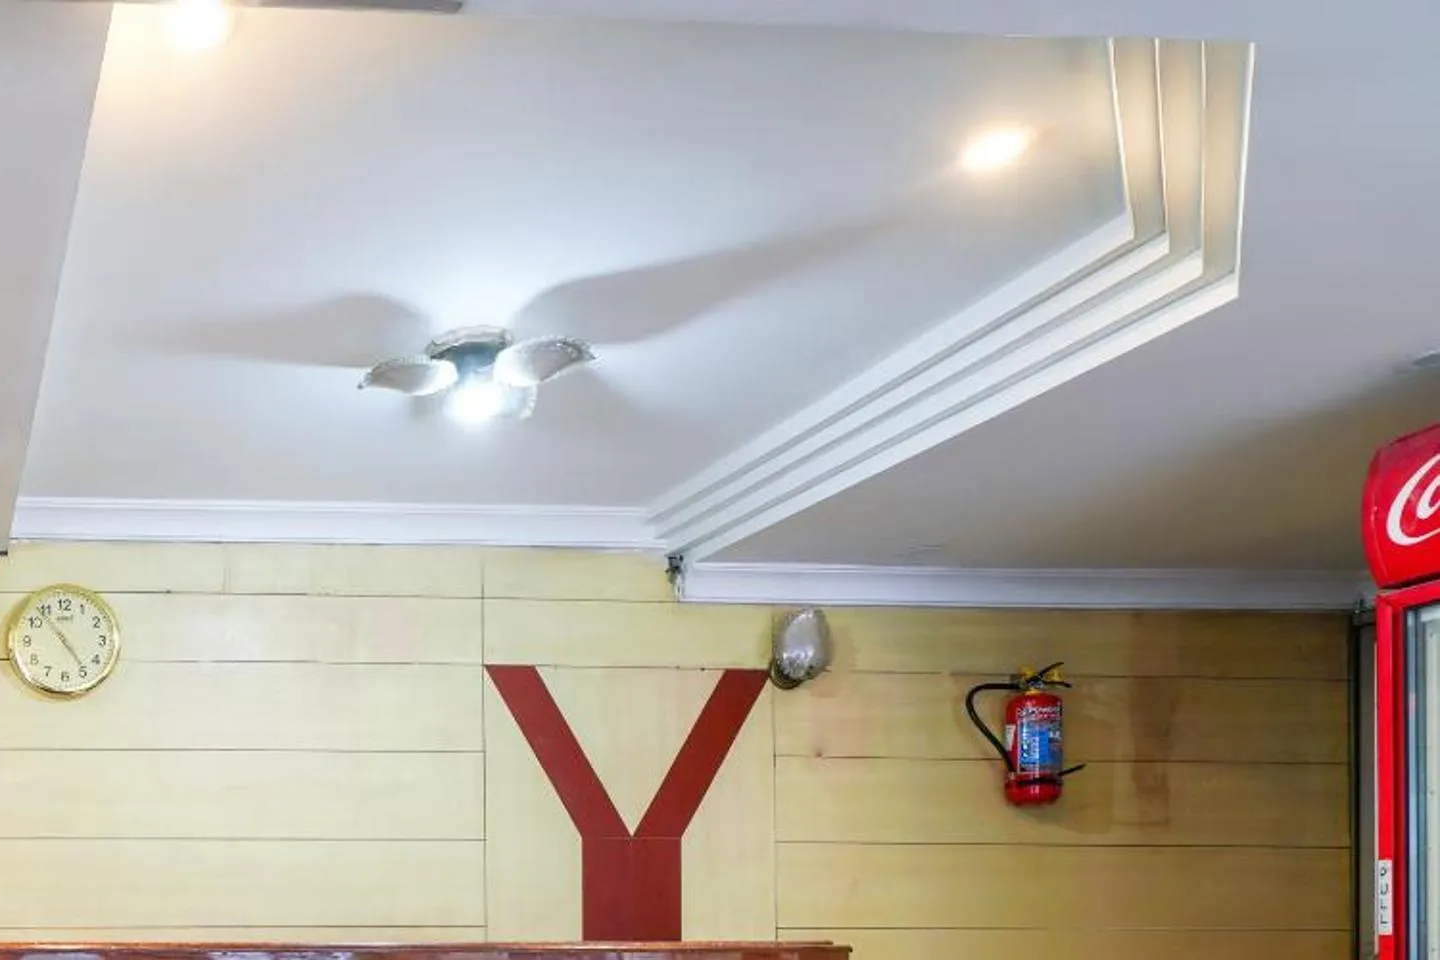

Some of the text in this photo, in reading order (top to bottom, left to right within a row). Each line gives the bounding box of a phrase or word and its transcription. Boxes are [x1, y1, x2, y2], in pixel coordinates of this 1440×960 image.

[37, 604, 51, 616] 11
[57, 599, 72, 611] 12
[29, 616, 43, 629] 10
[92, 616, 101, 628] 2
[23, 635, 32, 648] 9
[98, 635, 106, 647] 3
[29, 653, 39, 665] 8
[91, 654, 101, 664] 4
[43, 665, 52, 677] 7
[61, 671, 70, 682] 6
[78, 665, 87, 678] 5
